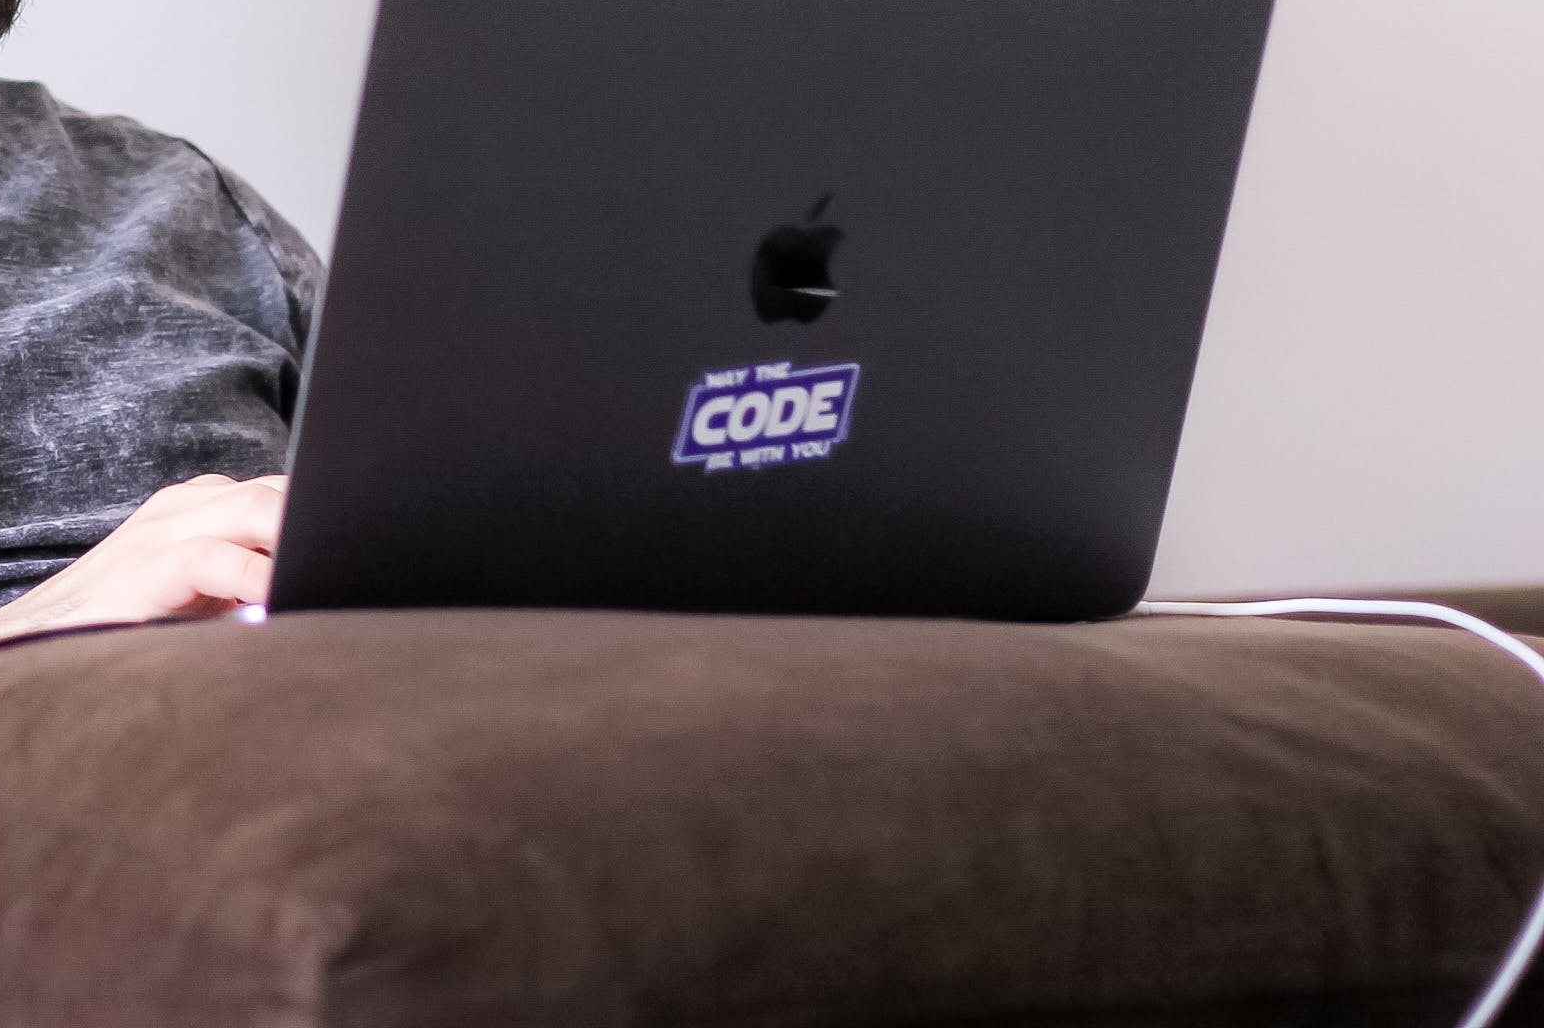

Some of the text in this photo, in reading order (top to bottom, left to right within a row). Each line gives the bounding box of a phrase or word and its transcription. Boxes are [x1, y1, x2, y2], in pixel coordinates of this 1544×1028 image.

[755, 362, 791, 381] THE
[692, 380, 844, 446] CODE
[740, 445, 785, 466] WITH
[792, 440, 831, 459] YOU
